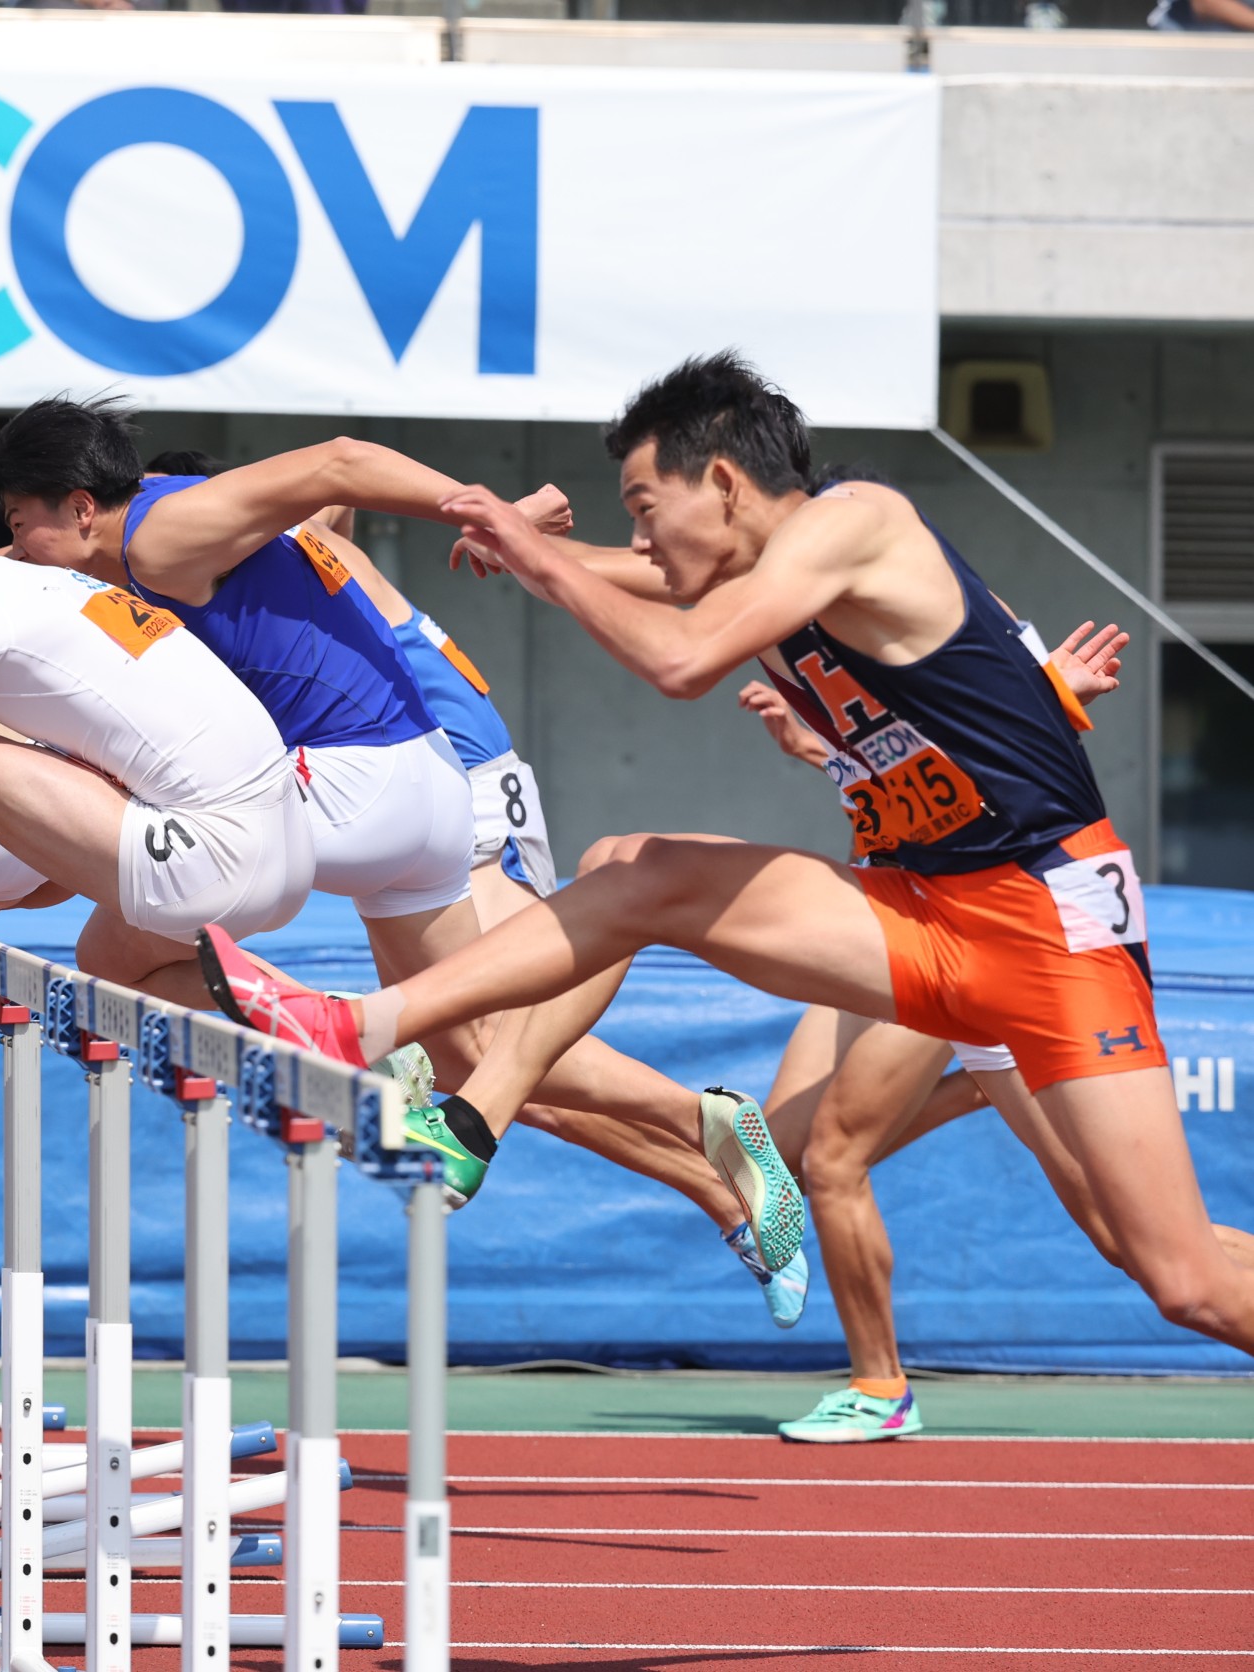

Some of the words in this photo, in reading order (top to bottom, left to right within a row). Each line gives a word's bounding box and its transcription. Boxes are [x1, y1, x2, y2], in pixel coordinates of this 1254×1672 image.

[500, 772, 527, 828] 8
[144, 817, 196, 862] 5
[1096, 862, 1130, 934] 3
[1093, 1025, 1148, 1057] H
[1172, 1057, 1235, 1112] HI
